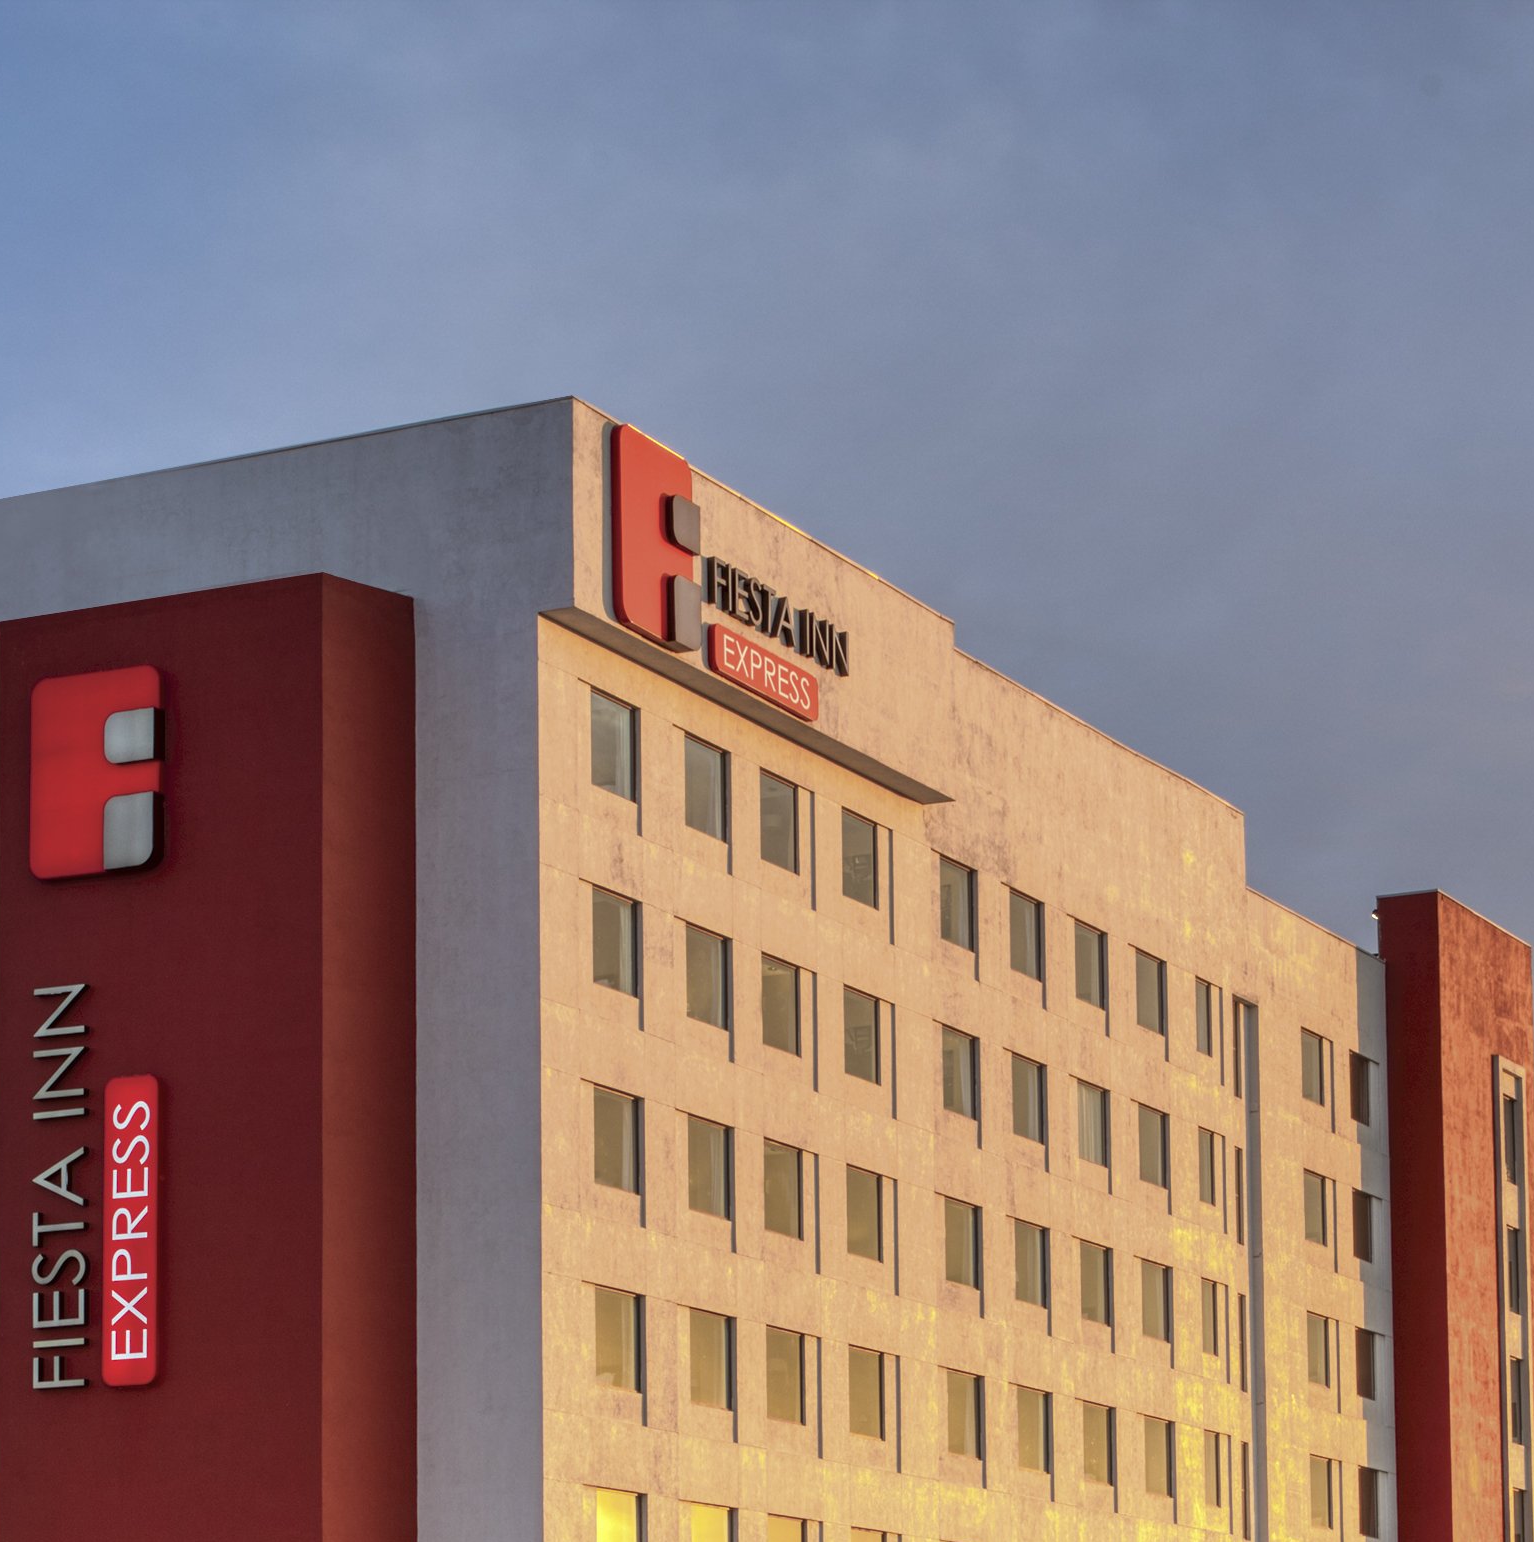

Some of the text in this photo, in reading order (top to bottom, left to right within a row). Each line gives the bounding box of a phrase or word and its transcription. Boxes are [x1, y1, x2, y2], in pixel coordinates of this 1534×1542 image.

[707, 556, 849, 677] FIESTA INN
[723, 633, 811, 710] EXPRESS
[31, 982, 90, 1390] FIESTA INN
[110, 1099, 151, 1362] EXPRESS
